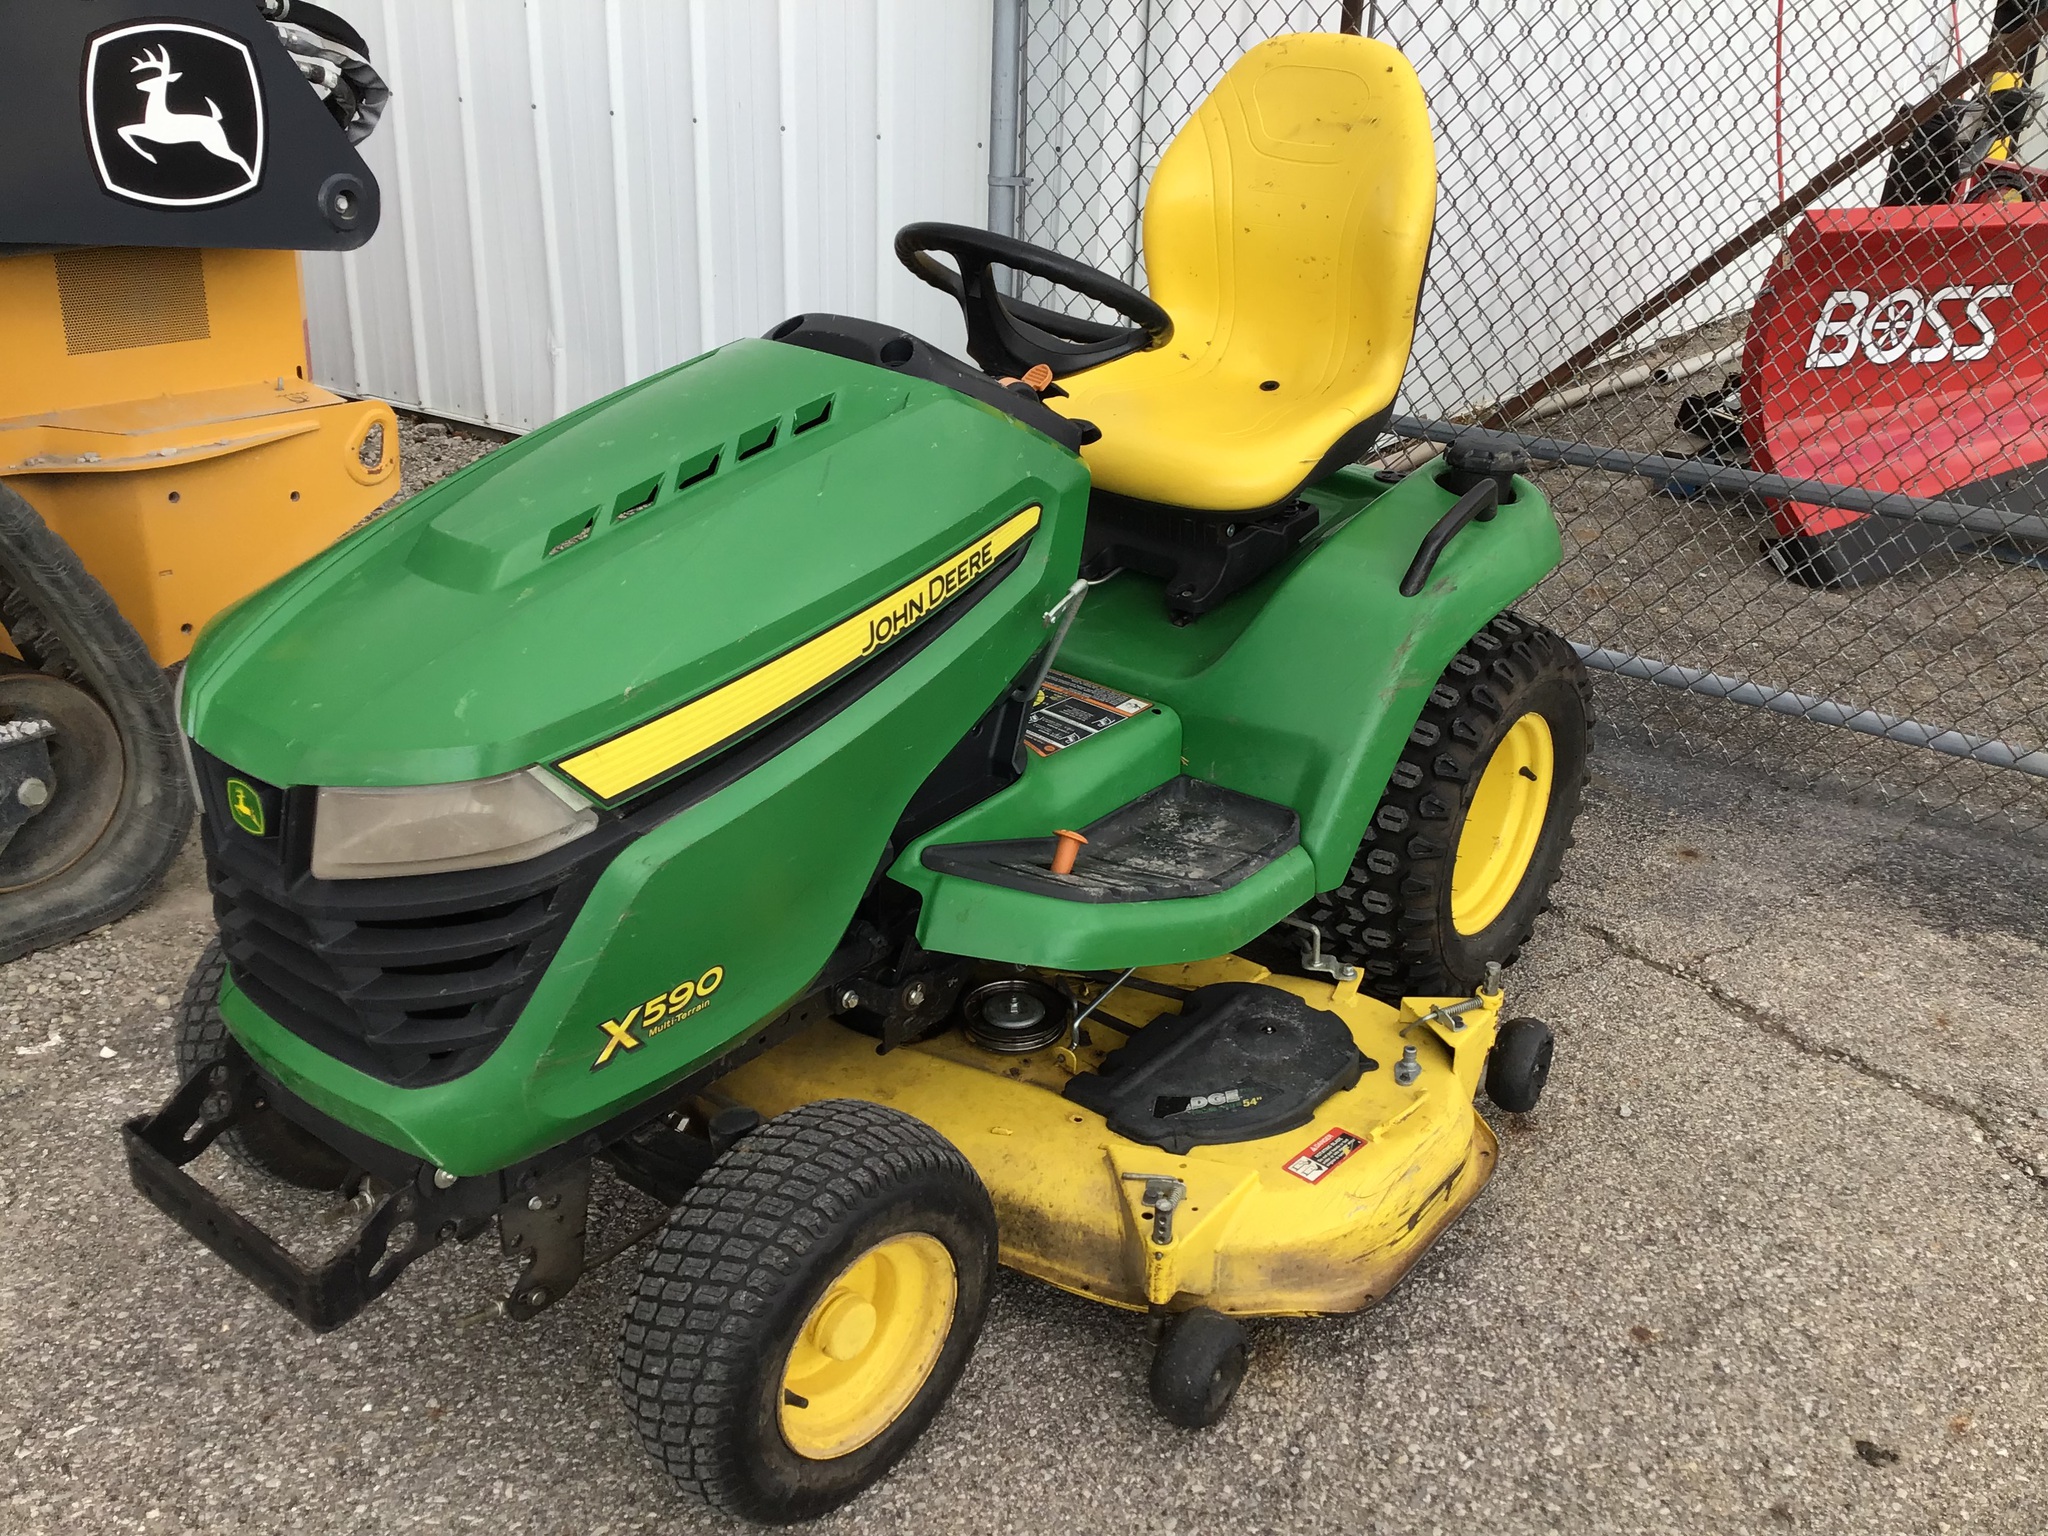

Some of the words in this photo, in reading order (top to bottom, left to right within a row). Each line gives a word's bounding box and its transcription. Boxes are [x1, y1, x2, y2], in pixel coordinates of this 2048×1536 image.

[1805, 284, 2015, 369] BOSS
[861, 591, 925, 654] JOHN
[929, 541, 994, 609] DEERE
[592, 965, 724, 1068] X590
[648, 999, 711, 1038] Multi-Terrain
[1186, 1089, 1241, 1110] DGE
[1242, 1096, 1263, 1108] 54"
